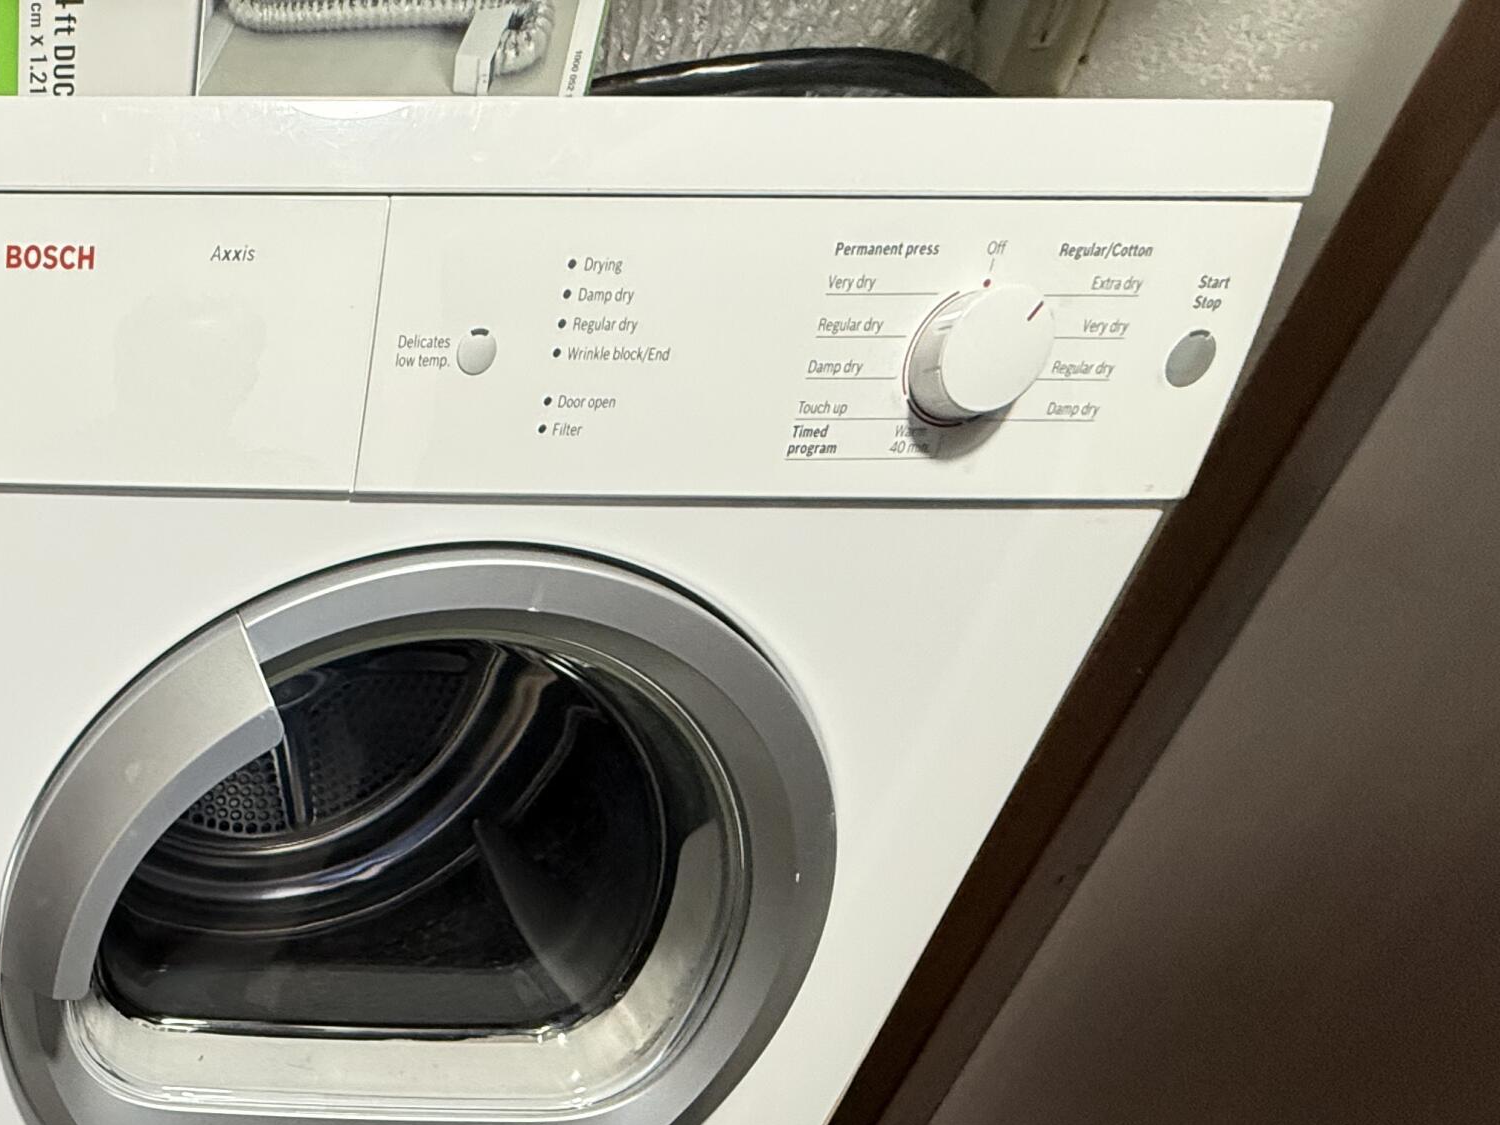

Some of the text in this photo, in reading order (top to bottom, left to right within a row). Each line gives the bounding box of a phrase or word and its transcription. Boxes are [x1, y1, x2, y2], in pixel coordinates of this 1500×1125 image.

[54, 13, 77, 36] ft
[29, 2, 48, 93] cm x 1.21
[53, 46, 76, 96] DUC
[210, 244, 256, 262] Axxis
[835, 242, 940, 259] Permanent press
[987, 239, 1009, 256] Off
[1059, 242, 1153, 260] Regular/Cotton
[6, 245, 95, 271] BOSCH
[584, 257, 623, 275] Drying
[828, 274, 876, 292] Very dry
[1091, 276, 1144, 293] Extra dry
[1198, 275, 1231, 290] Start
[578, 288, 635, 305] Damp dry
[1193, 296, 1222, 311] Stop
[572, 317, 638, 335] Regular dry
[817, 317, 884, 334] Regular dry
[1083, 319, 1130, 336] Very dry
[397, 335, 451, 349] Delicates
[395, 354, 450, 371] low temp.
[567, 347, 671, 363] Wrinkle block/End
[808, 359, 864, 377] Damp dry
[1051, 360, 1115, 378] Regular dry
[557, 396, 616, 411] Door open
[798, 400, 848, 417] Touch up
[1046, 401, 1100, 419] Damp dry
[552, 423, 583, 437] Filter
[792, 424, 829, 439] Timed
[787, 441, 837, 457] program
[889, 440, 906, 454] 40
